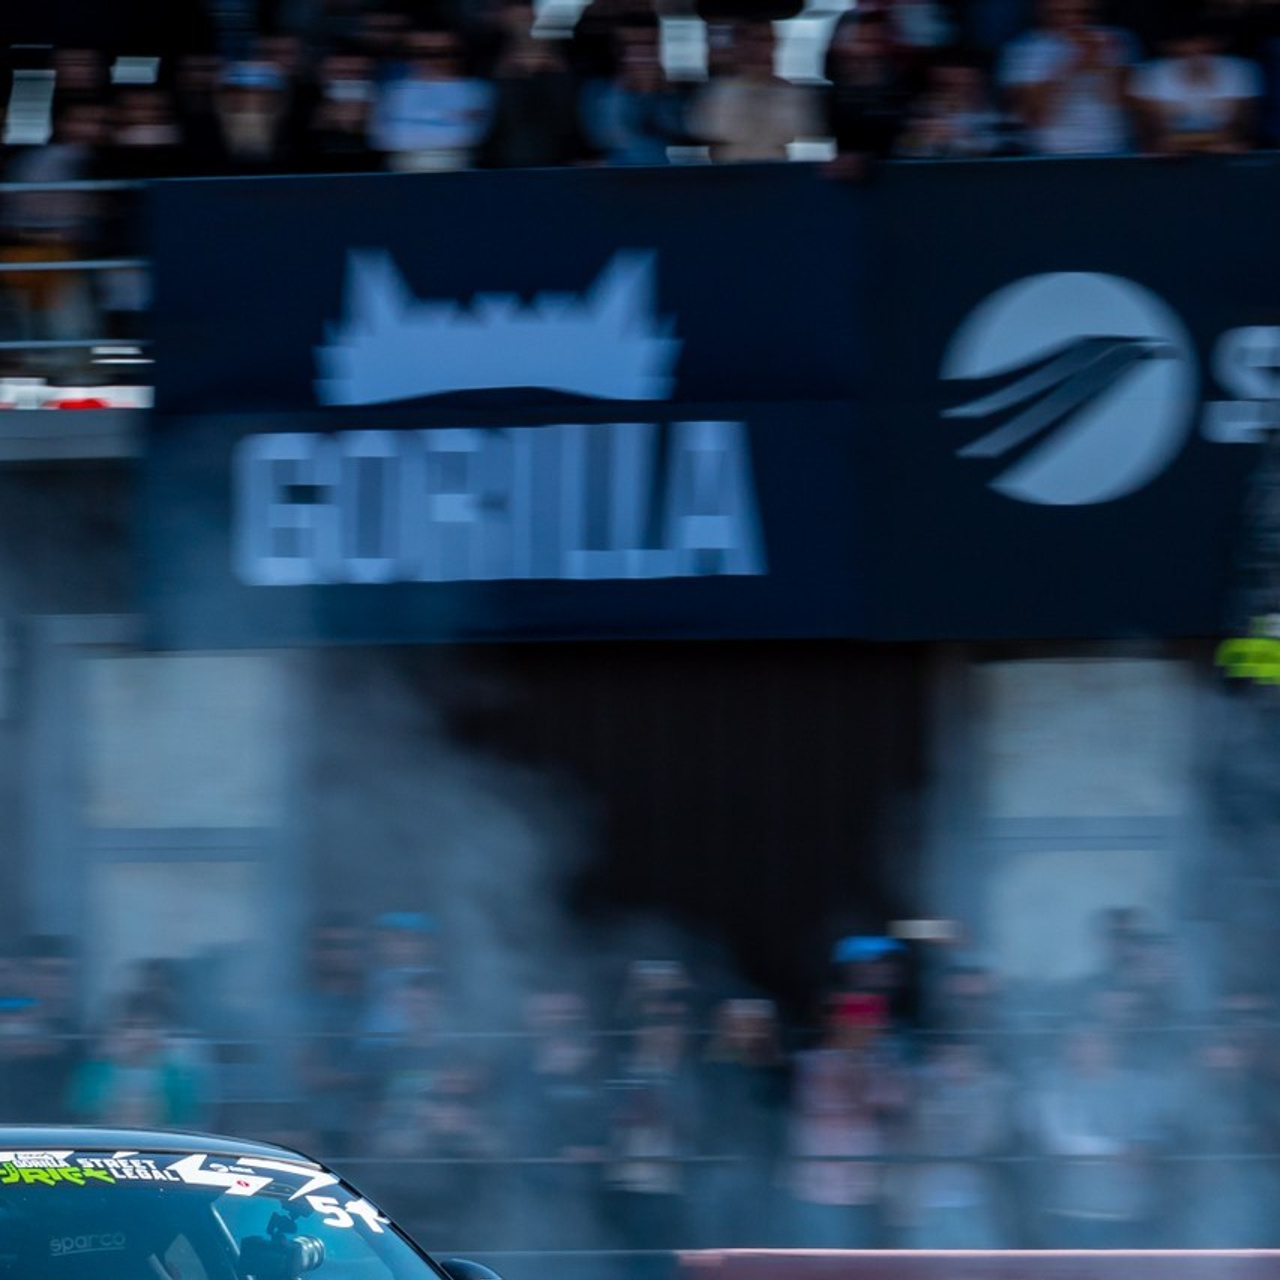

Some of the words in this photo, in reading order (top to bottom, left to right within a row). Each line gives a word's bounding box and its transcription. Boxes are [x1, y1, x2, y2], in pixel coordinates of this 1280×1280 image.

[232, 421, 768, 586] GORILLA
[76, 1158, 157, 1169] STREET
[108, 1168, 182, 1181] LEGAL
[49, 1232, 126, 1255] sparco
